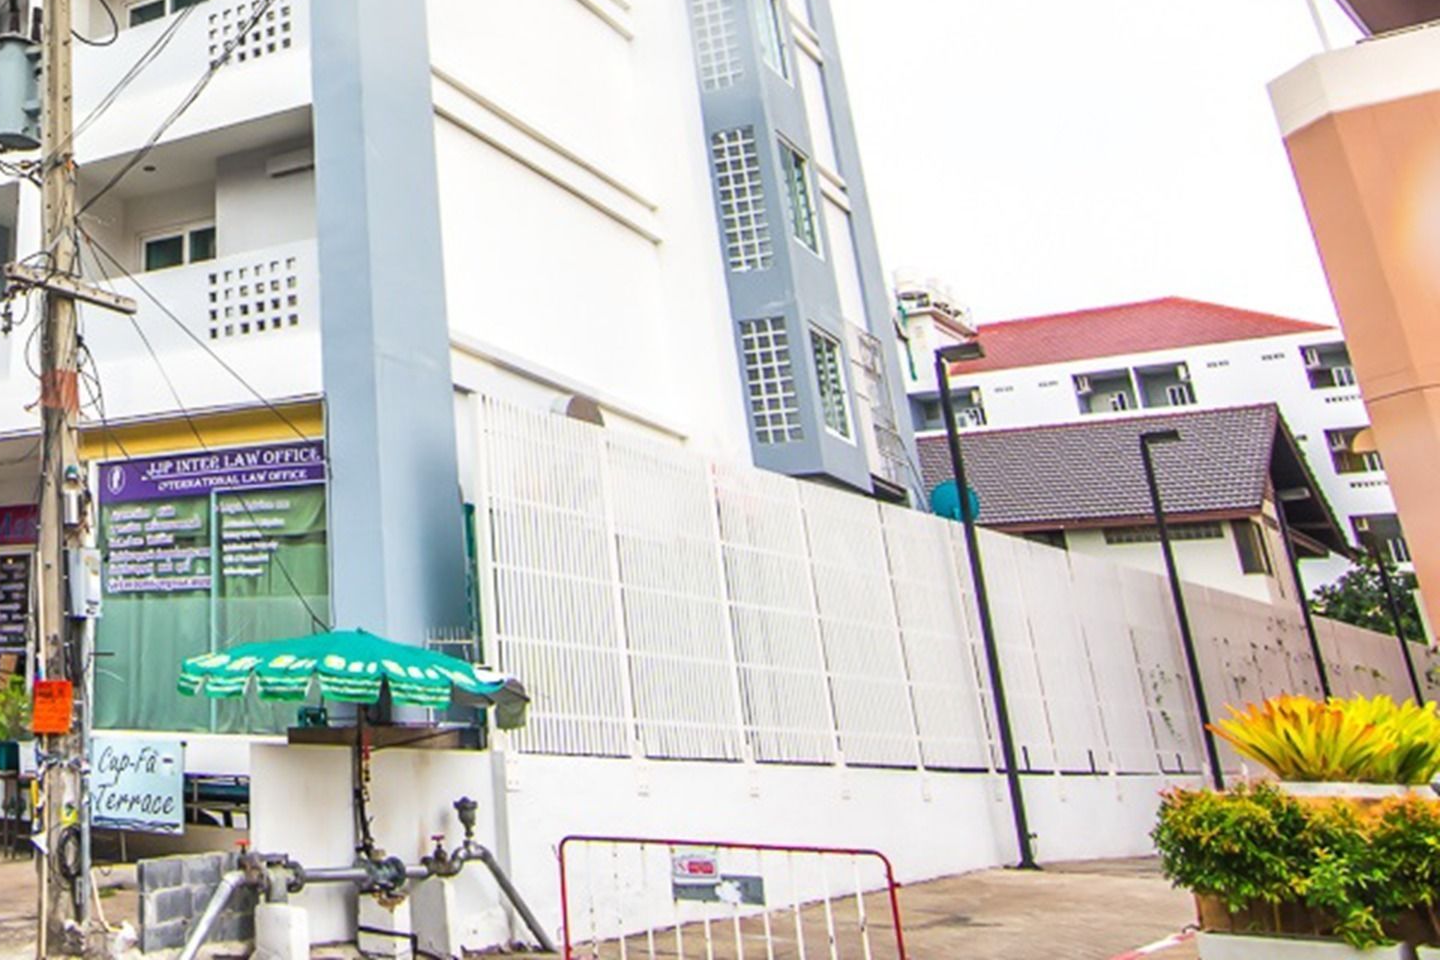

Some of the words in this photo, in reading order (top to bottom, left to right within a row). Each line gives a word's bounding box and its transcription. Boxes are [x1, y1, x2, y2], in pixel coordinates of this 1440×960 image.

[224, 450, 261, 468] LAW
[263, 447, 321, 465] OFFICE
[242, 470, 266, 482] LAW
[269, 468, 307, 481] OFFICE
[95, 784, 174, 814] Terrace
